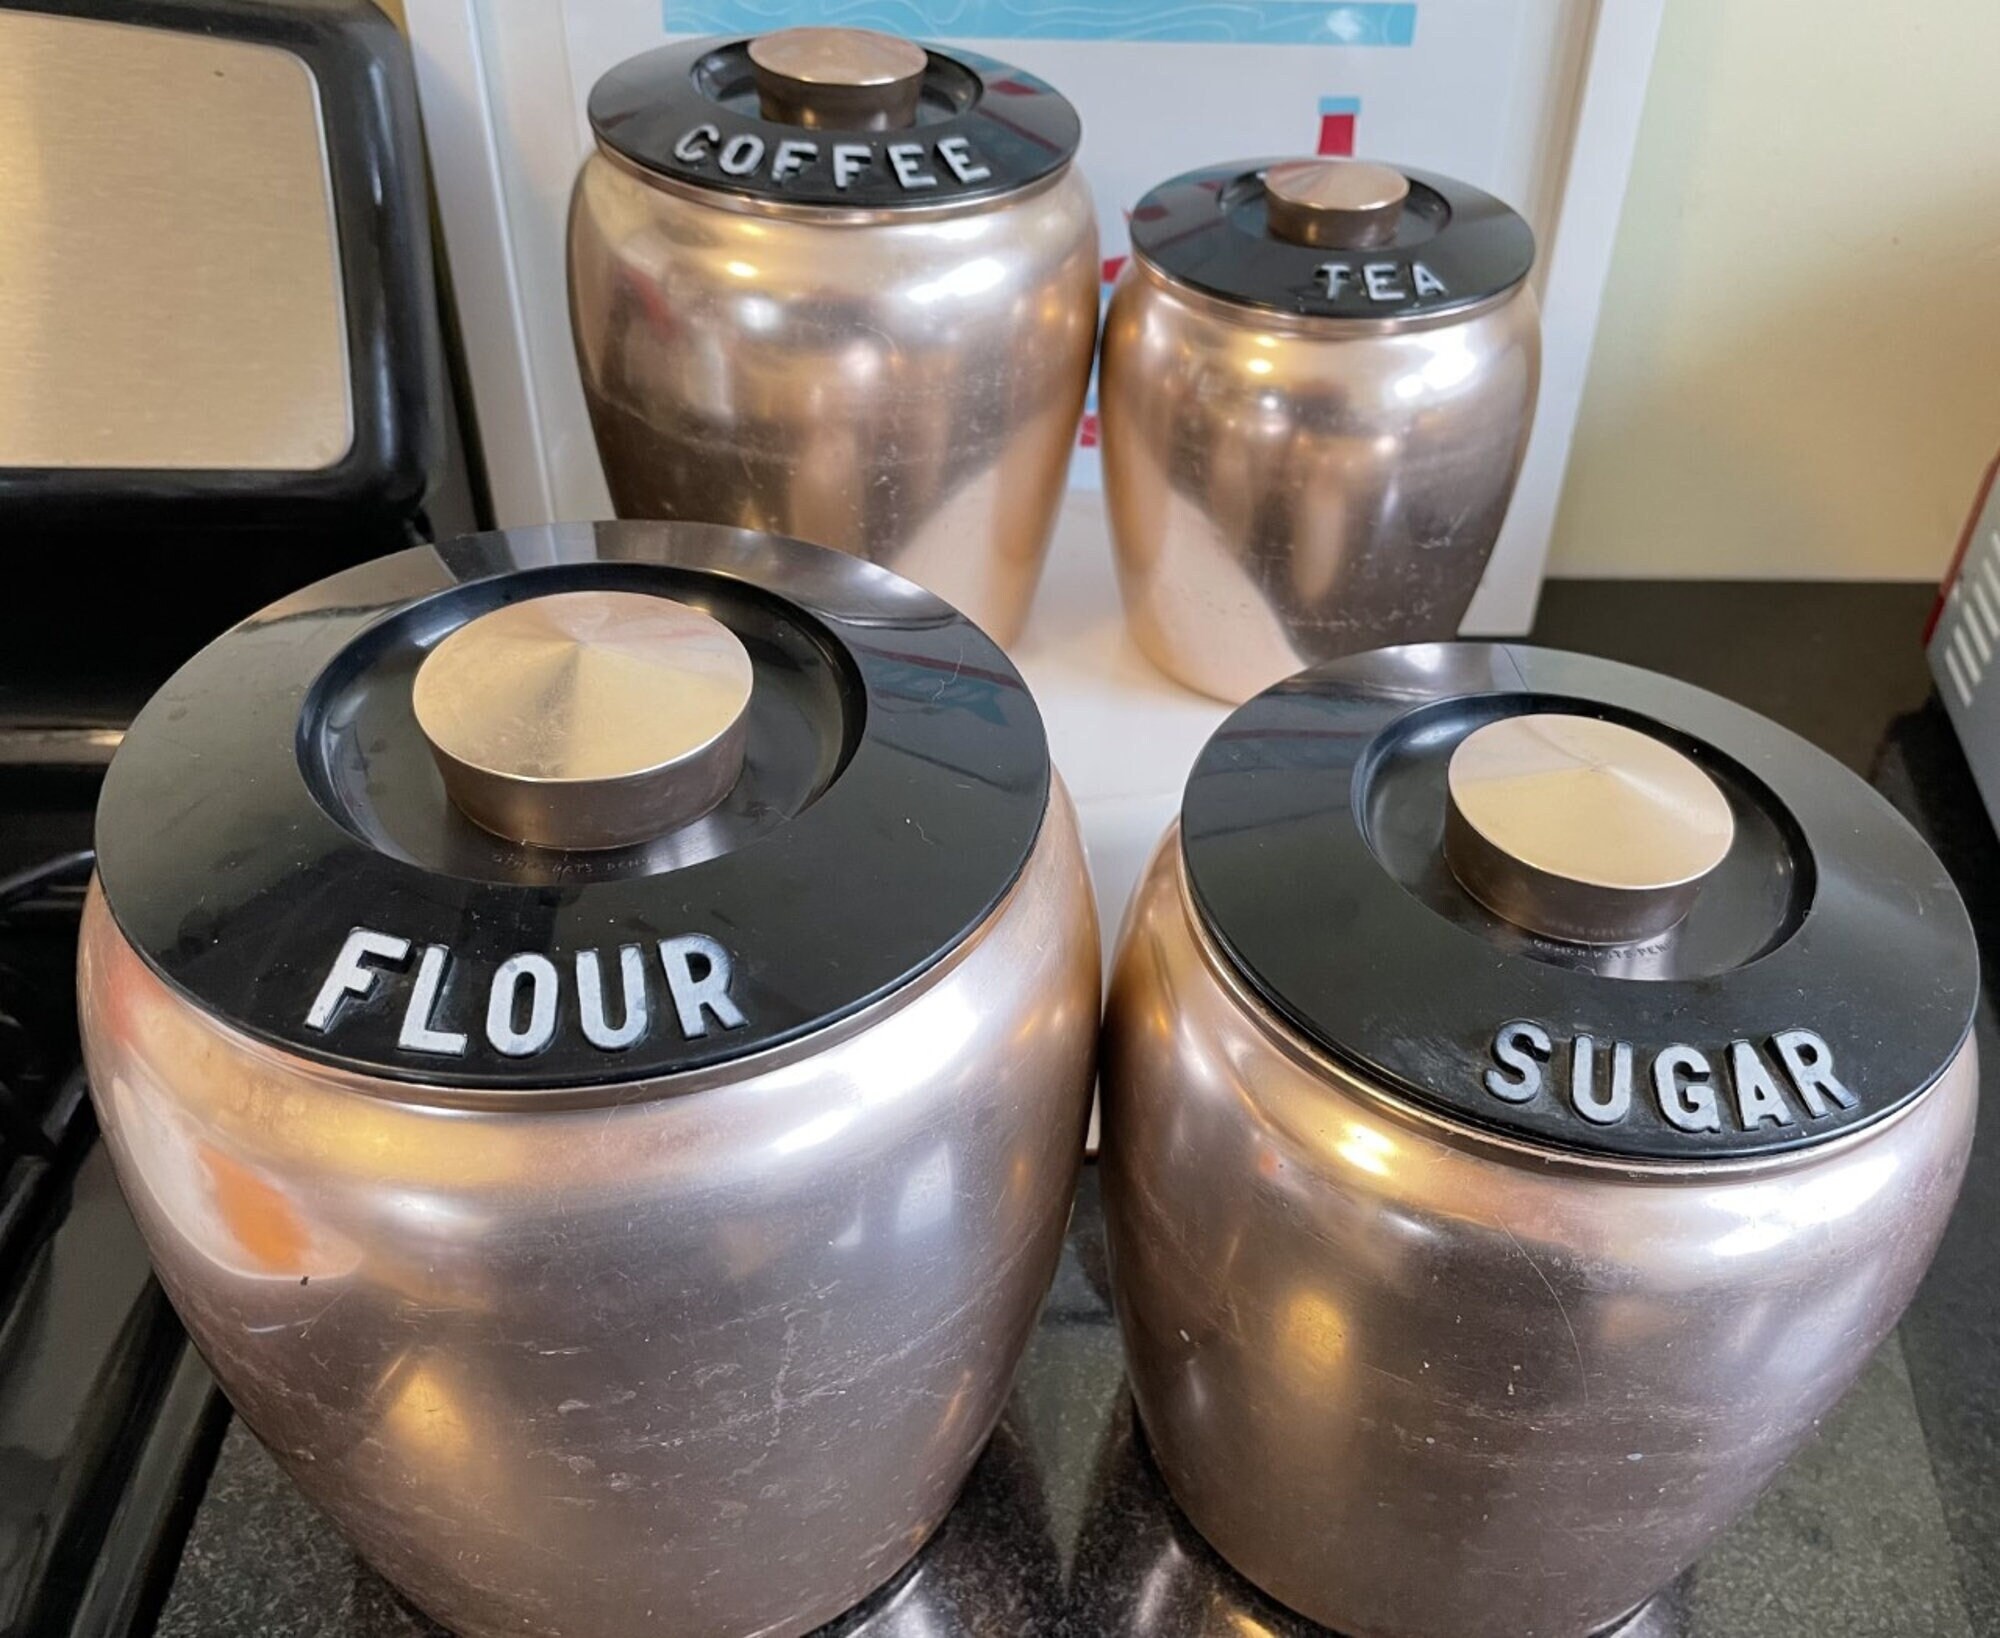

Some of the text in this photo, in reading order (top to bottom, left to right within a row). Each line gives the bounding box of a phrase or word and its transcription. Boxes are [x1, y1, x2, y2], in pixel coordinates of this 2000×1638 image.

[674, 122, 991, 190] COFFEE
[1317, 261, 1449, 301] TEA
[304, 926, 749, 1058] FLOUR
[1483, 1017, 1858, 1134] SUGAR
